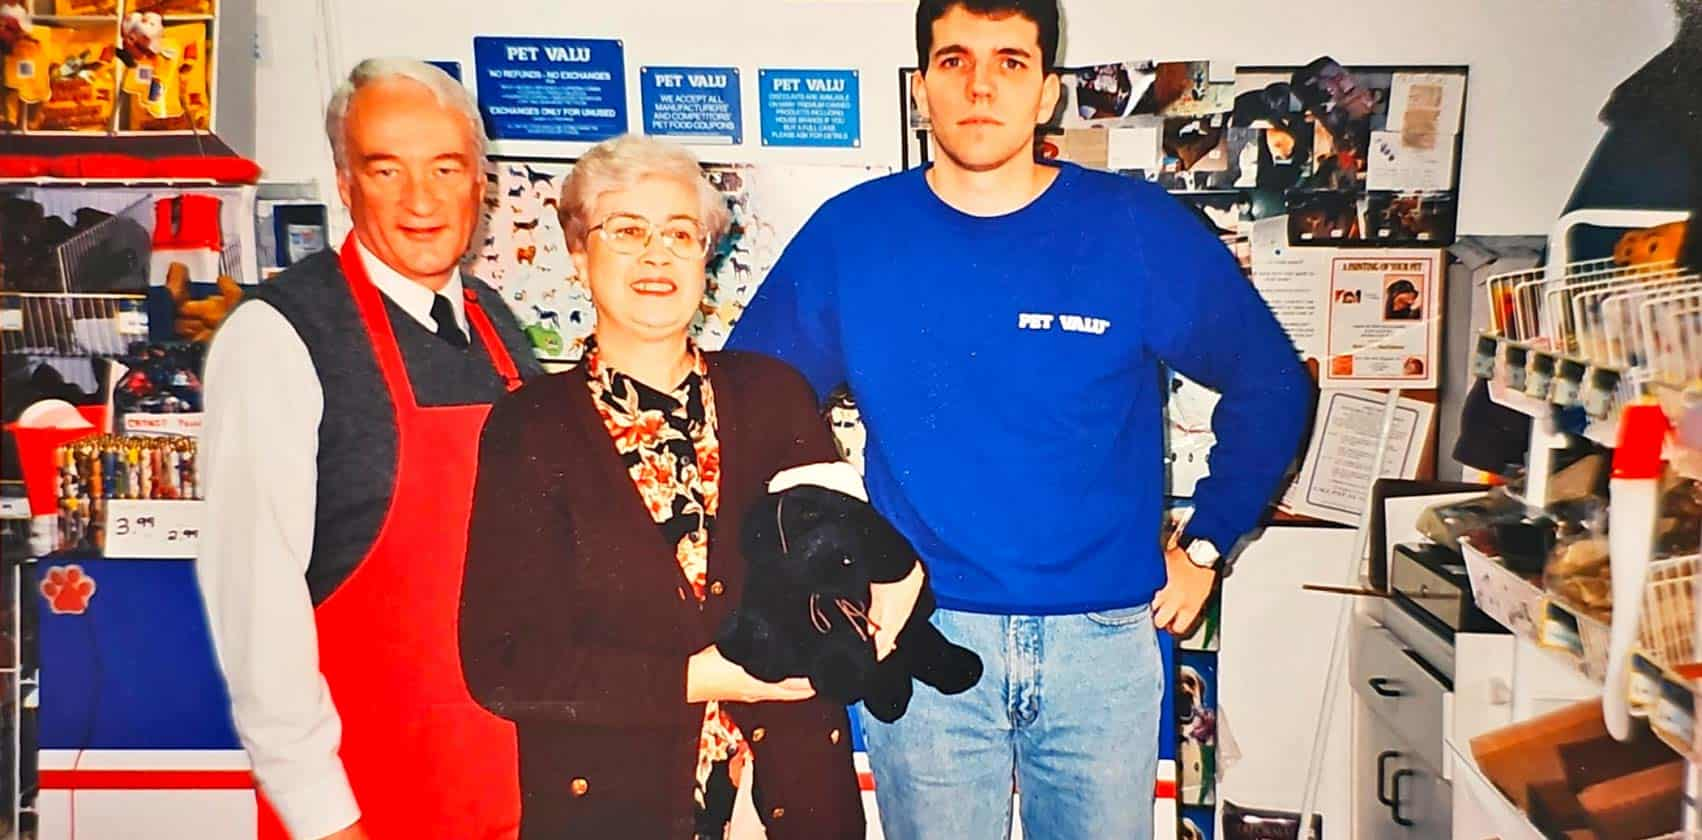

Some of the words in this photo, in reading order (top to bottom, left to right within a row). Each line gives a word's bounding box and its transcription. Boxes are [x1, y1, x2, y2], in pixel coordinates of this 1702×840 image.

[507, 46, 539, 61] PET
[543, 46, 591, 62] VALU
[489, 69, 501, 78] NO
[503, 70, 541, 79] REFUNDS
[546, 71, 559, 80] NO
[560, 71, 611, 80] EXCHANGES
[655, 74, 683, 87] PET
[687, 75, 727, 88] VALU
[773, 78, 800, 91] PET
[805, 78, 845, 92] VALU
[660, 95, 673, 103] WE
[675, 95, 706, 103] ACCEPT
[489, 106, 539, 116] EXCHANGES
[541, 107, 561, 116] ONLY
[563, 108, 580, 117] FOR
[654, 112, 671, 120] AND
[652, 121, 667, 129] PET
[669, 121, 692, 129] FOOD
[693, 121, 735, 130] COUPONS
[1019, 313, 1054, 329] PET
[116, 516, 155, 535] 3.99
